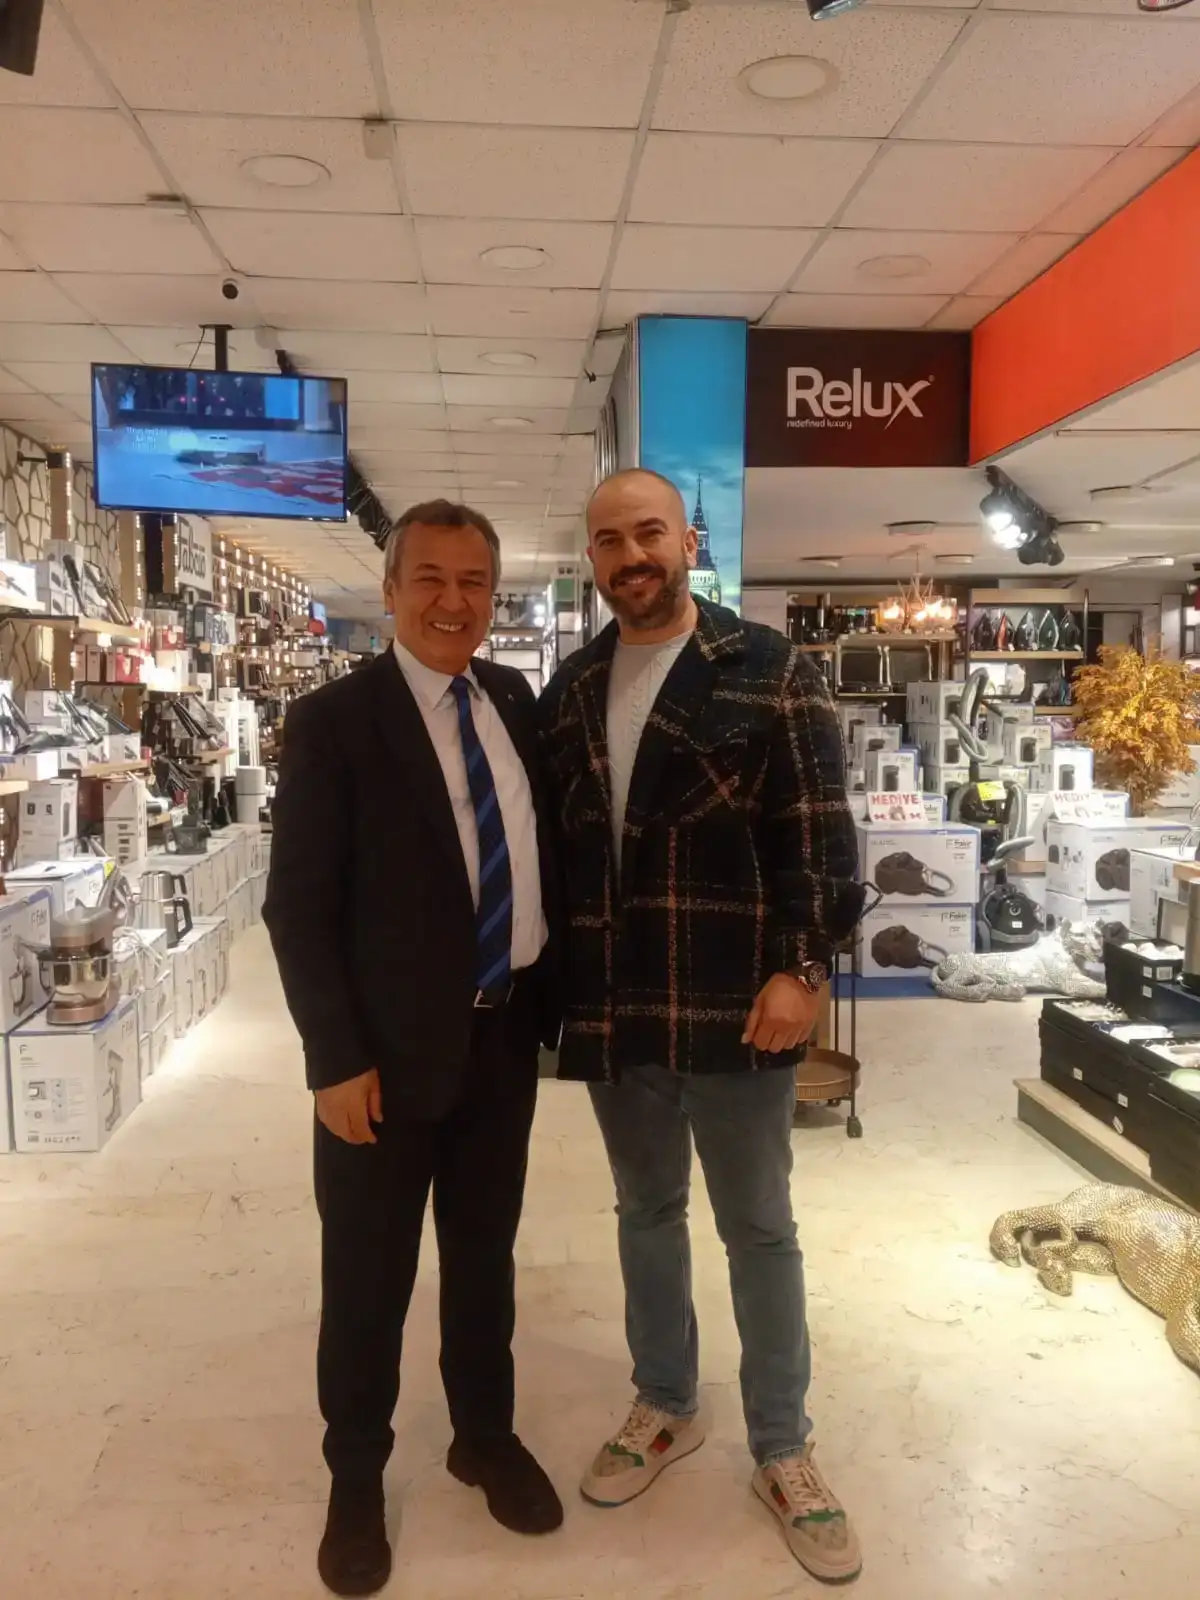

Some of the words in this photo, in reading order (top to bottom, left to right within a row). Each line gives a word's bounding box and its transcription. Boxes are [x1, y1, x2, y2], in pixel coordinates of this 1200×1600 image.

[787, 366, 931, 429] Relux
[787, 418, 825, 428] redefined
[826, 418, 852, 430] luxury
